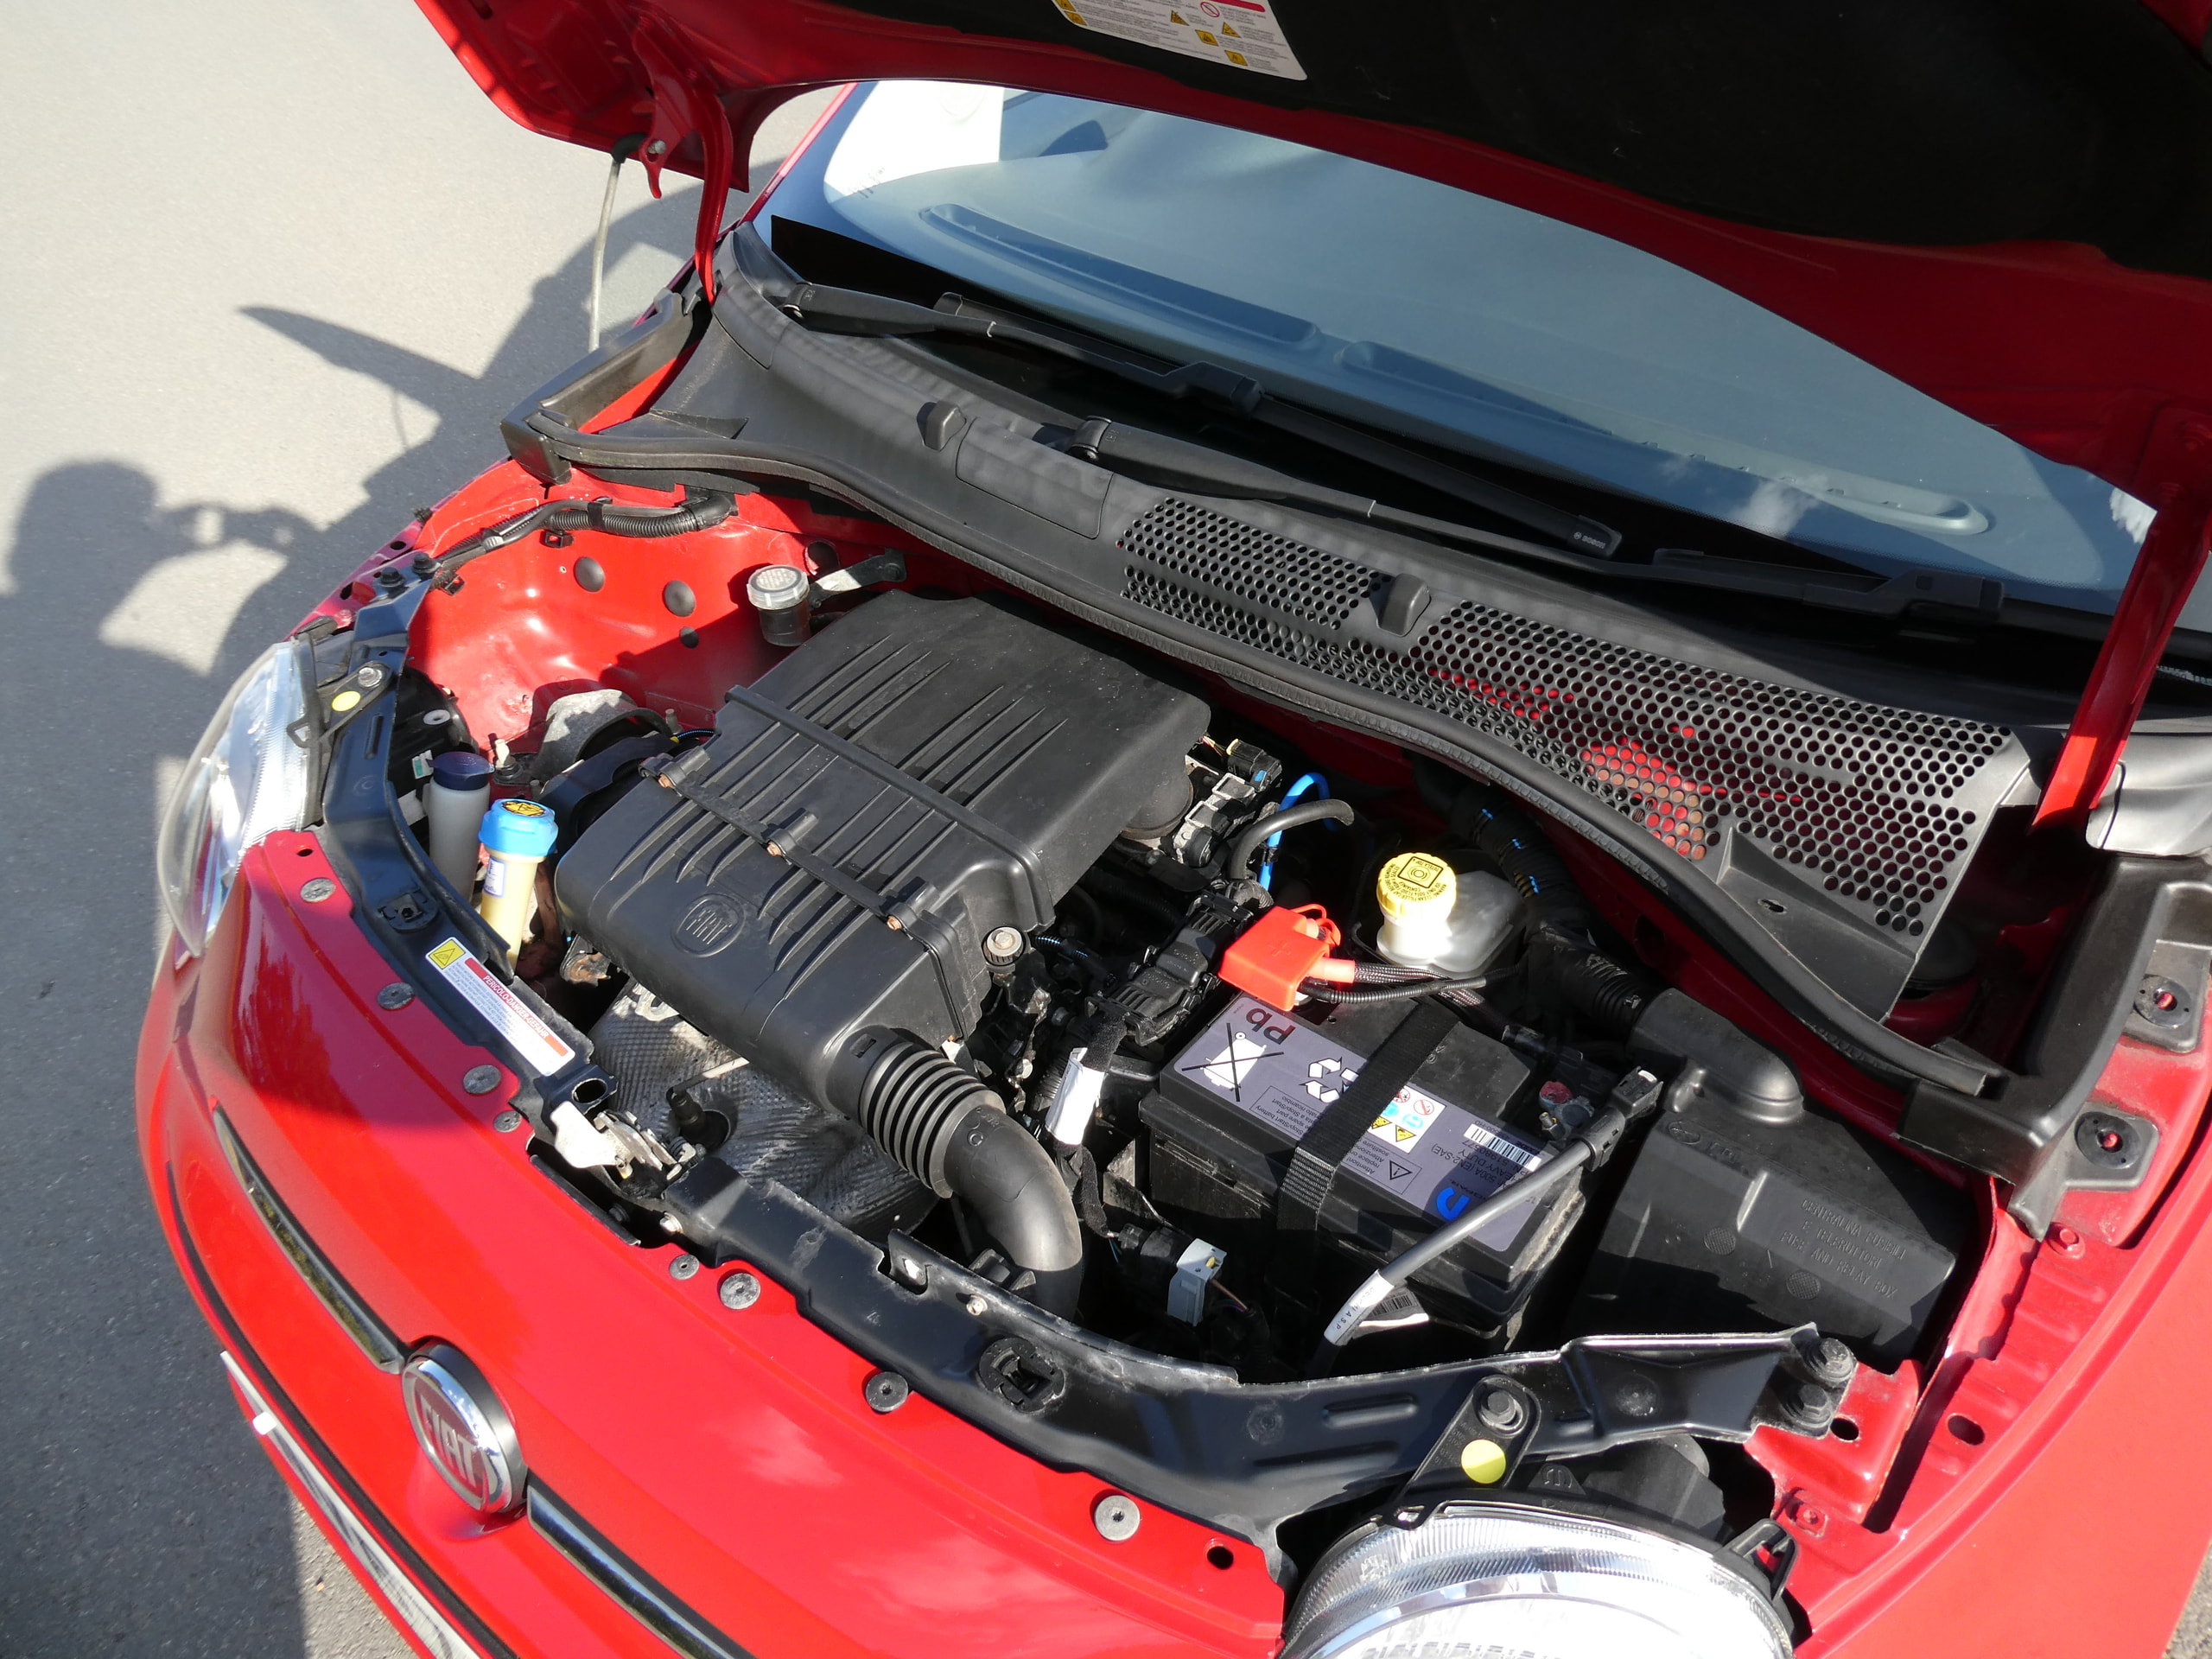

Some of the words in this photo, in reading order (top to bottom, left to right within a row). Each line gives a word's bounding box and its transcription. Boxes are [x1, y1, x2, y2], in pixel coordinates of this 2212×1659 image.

[685, 909, 733, 945] FIAT
[1245, 1007, 1298, 1045] Pb
[1254, 1104, 1276, 1119] battery
[1457, 1147, 1486, 1166] DUTY
[419, 1394, 478, 1489] FIAT
